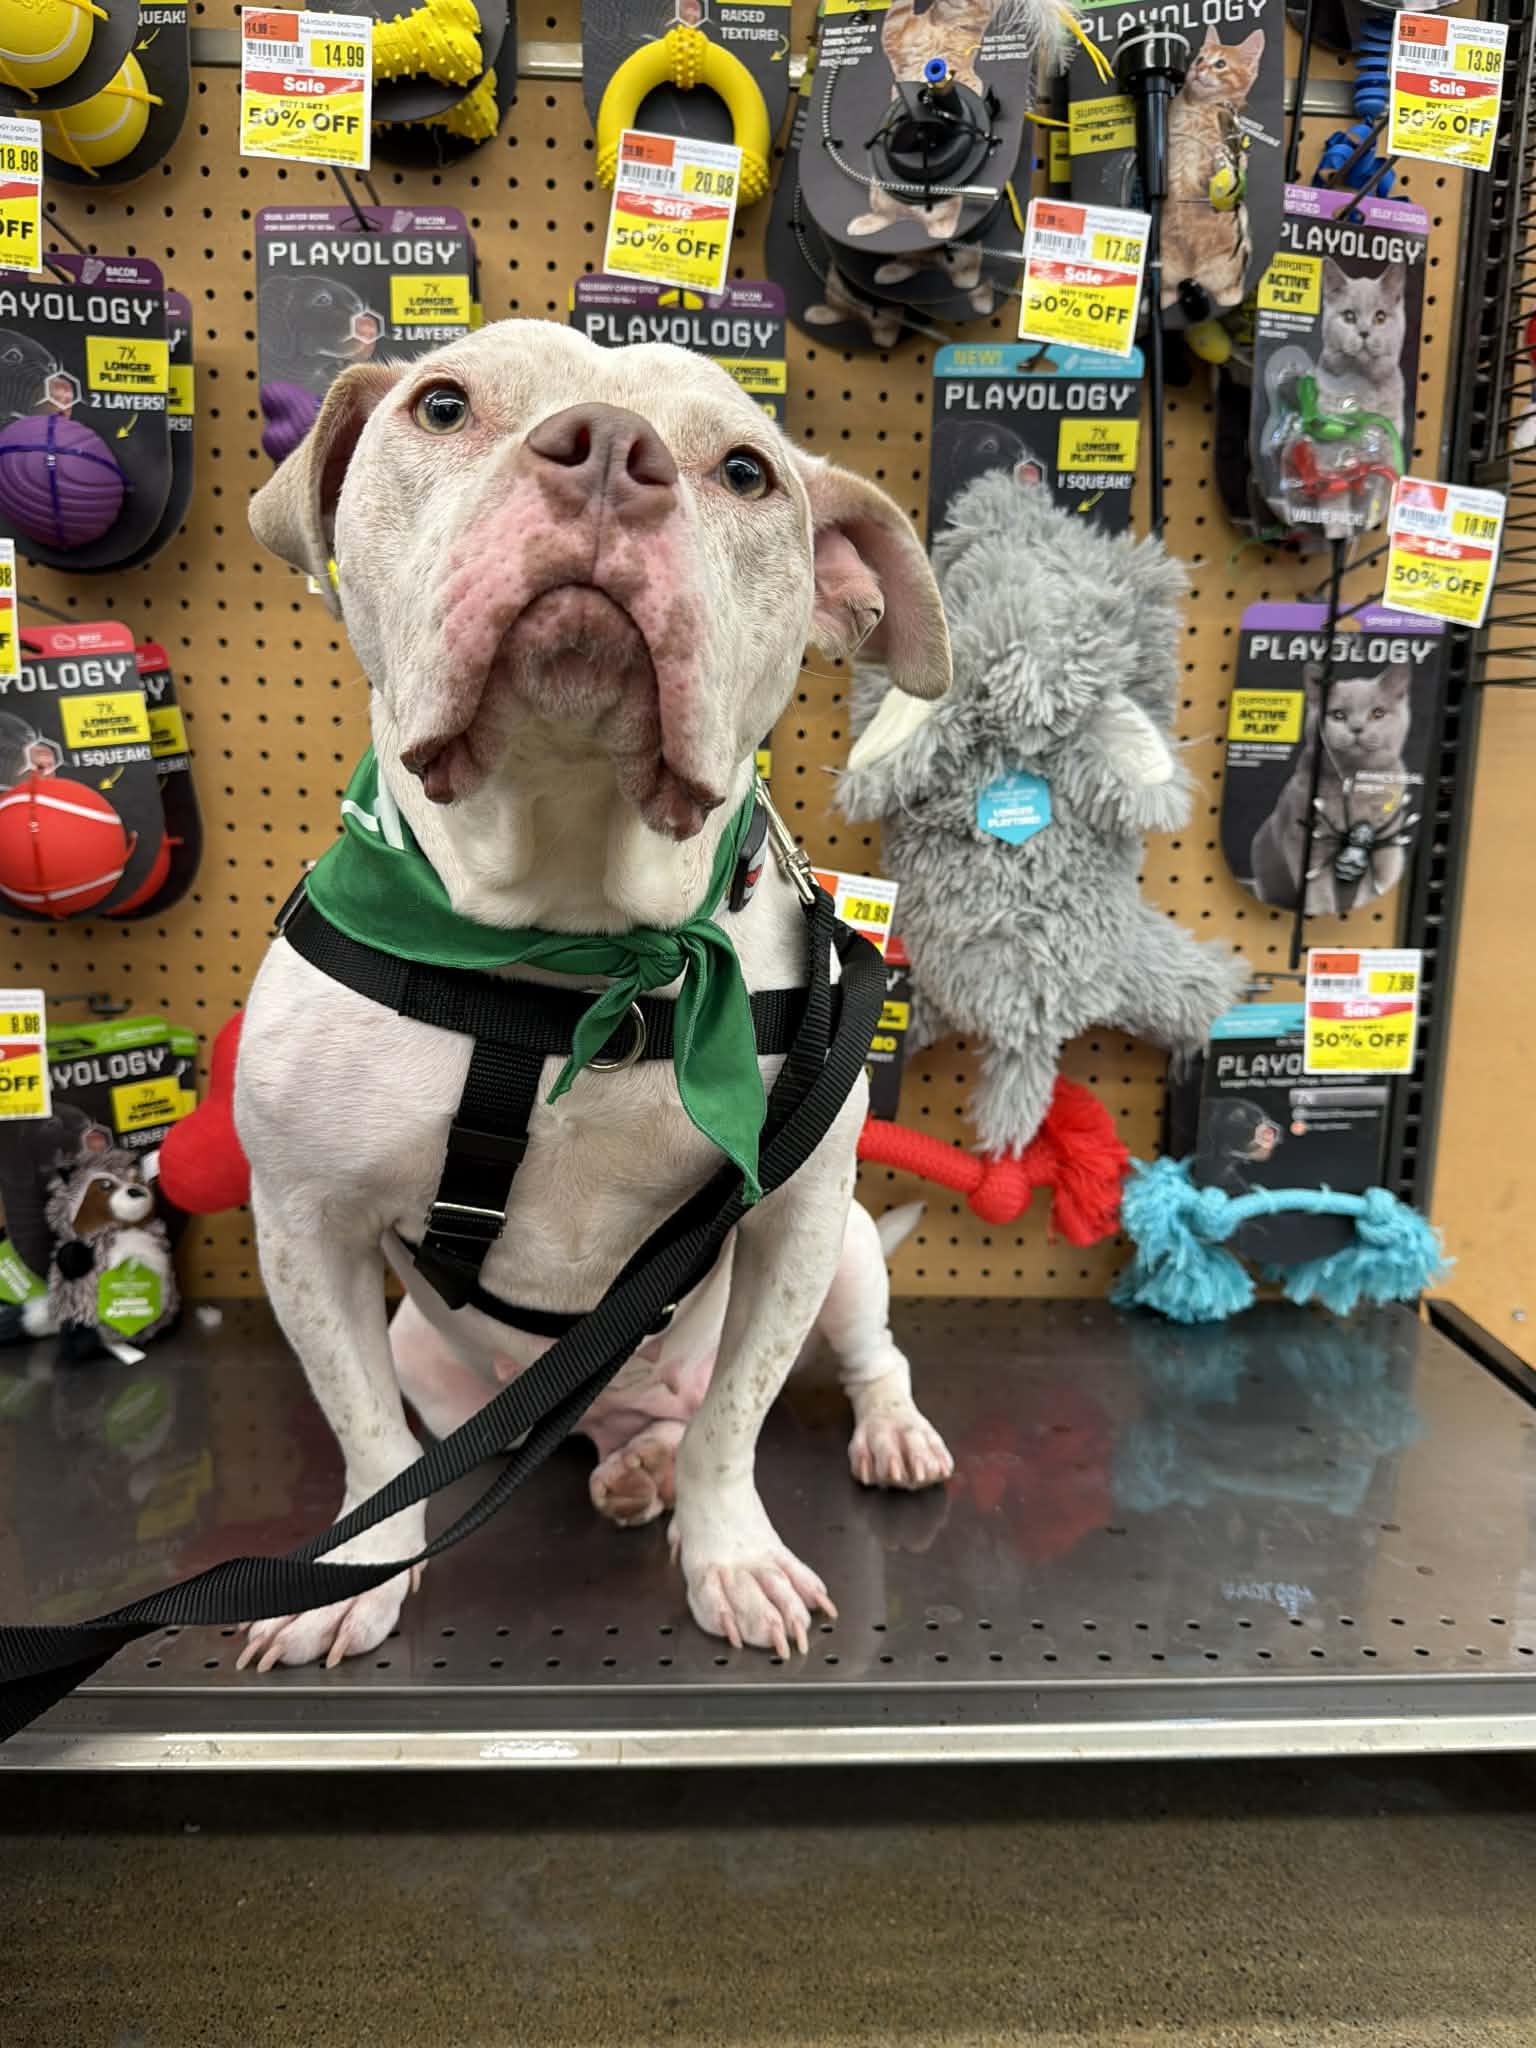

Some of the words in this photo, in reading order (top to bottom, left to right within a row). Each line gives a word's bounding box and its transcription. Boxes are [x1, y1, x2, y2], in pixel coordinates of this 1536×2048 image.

[721, 9, 765, 23] RAISED
[720, 27, 779, 41] TEXTURE!
[324, 43, 364, 68] 14.99
[1467, 48, 1502, 74] 13.98
[283, 76, 325, 93] Sale
[1429, 78, 1466, 97] Sale
[249, 106, 306, 128] 50%
[312, 112, 359, 135] OFF
[1398, 106, 1447, 131] 50%
[1452, 114, 1491, 138] OFF
[0, 147, 39, 173] 18.98
[694, 170, 734, 198] 20.98
[652, 198, 694, 218] Sale
[0, 219, 35, 240] FF
[616, 227, 669, 253] 50%
[677, 237, 721, 260] OFF
[268, 241, 456, 267] PLAYOLOGY
[1064, 265, 1103, 285] Sale
[1267, 272, 1311, 290] ACTIVE
[423, 284, 441, 296] 7X
[1272, 289, 1303, 304] PLAY
[0, 290, 153, 325] AYOLOGY
[409, 297, 454, 307] LONGER
[1029, 294, 1081, 318] 50%
[1087, 303, 1129, 324] OFF
[404, 307, 461, 317] PLAYTIME
[392, 326, 404, 340] 2
[586, 313, 774, 349] PLAYOLOGY
[119, 346, 137, 362] 7X
[105, 360, 152, 373] LONGER
[100, 372, 157, 386] PLAYTIME
[91, 393, 102, 408] 2
[105, 393, 166, 411] LAYERS!
[944, 382, 1131, 411] PLAYOLOGY
[1076, 442, 1120, 452] LONGER
[1071, 453, 1125, 464] PLAYTIME
[1066, 473, 1132, 490] SQUEAK!
[1394, 565, 1441, 589] 50%
[1446, 577, 1483, 597] OFF
[1249, 635, 1433, 665] PLAYOLOGY
[83, 714, 131, 727] LONGER
[1238, 709, 1288, 721] ACTIVE
[80, 725, 140, 739] PLAYTIME
[1243, 723, 1279, 735] PLAY
[72, 753, 80, 768] I
[81, 745, 152, 767] SQUEAK!
[1312, 1031, 1363, 1049] 50%
[1368, 1032, 1408, 1048] OFF
[1217, 1053, 1305, 1077] PLAYO
